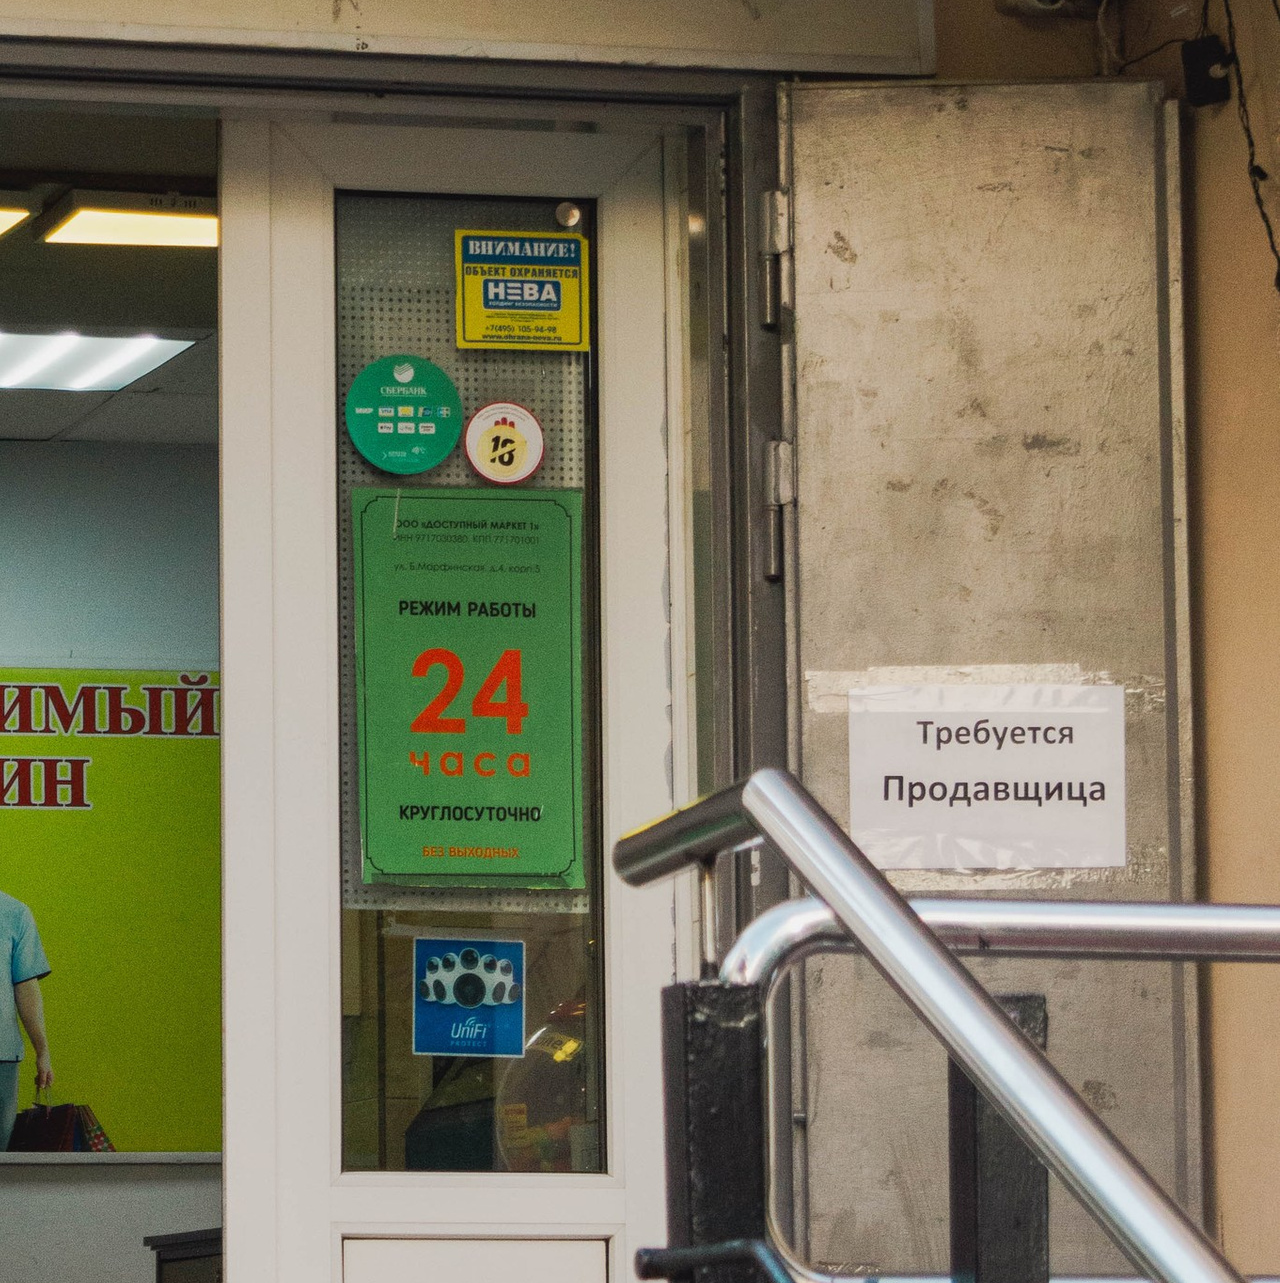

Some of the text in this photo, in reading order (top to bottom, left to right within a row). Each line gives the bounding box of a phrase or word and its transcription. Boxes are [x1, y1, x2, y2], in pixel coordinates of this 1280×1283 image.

[468, 240, 576, 258] ВНИМАНИЕ!
[465, 266, 579, 279] ОБЪЕКТ ОХРАНЯЕТСЯ
[380, 386, 427, 395] СБЕРБАНК
[490, 521, 528, 531] МАРКЕТ
[399, 600, 537, 619] РЕЖИМ РАБОТЫ
[409, 646, 530, 736] 24
[916, 719, 1075, 751] Требуется
[408, 749, 532, 778] часа
[882, 774, 1107, 808] Продавщица
[398, 803, 542, 823] КРУГЛОСУТОЧНО
[422, 845, 520, 860] БЕЗ ВЫХОДНЫХ
[450, 1020, 488, 1039] UniFi
[450, 1040, 488, 1048] PROTECT
